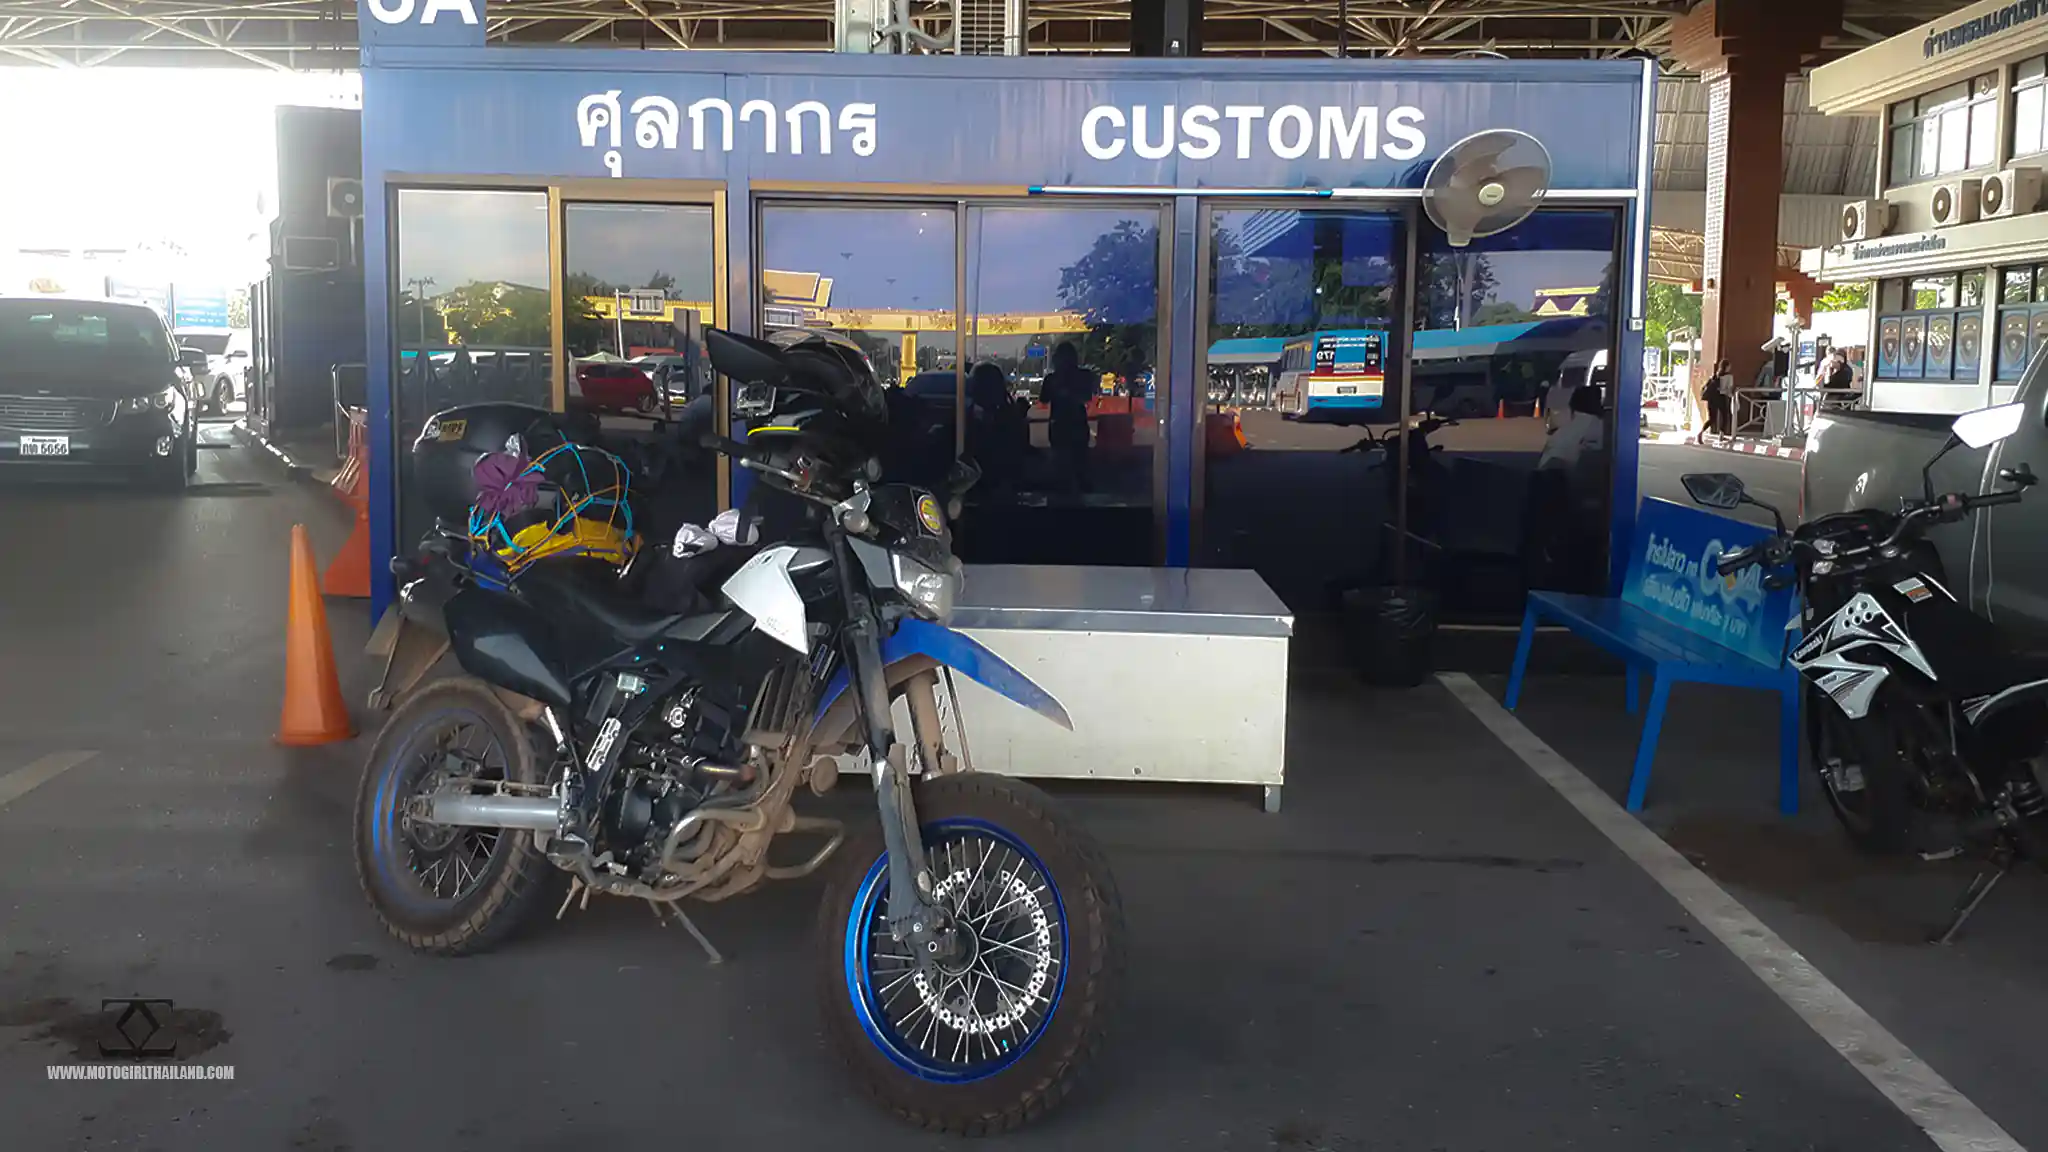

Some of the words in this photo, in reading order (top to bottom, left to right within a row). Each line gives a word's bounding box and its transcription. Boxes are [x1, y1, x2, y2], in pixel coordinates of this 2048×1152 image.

[578, 91, 875, 177] ศุลกากร
[1081, 104, 1426, 160] CUSTOMS
